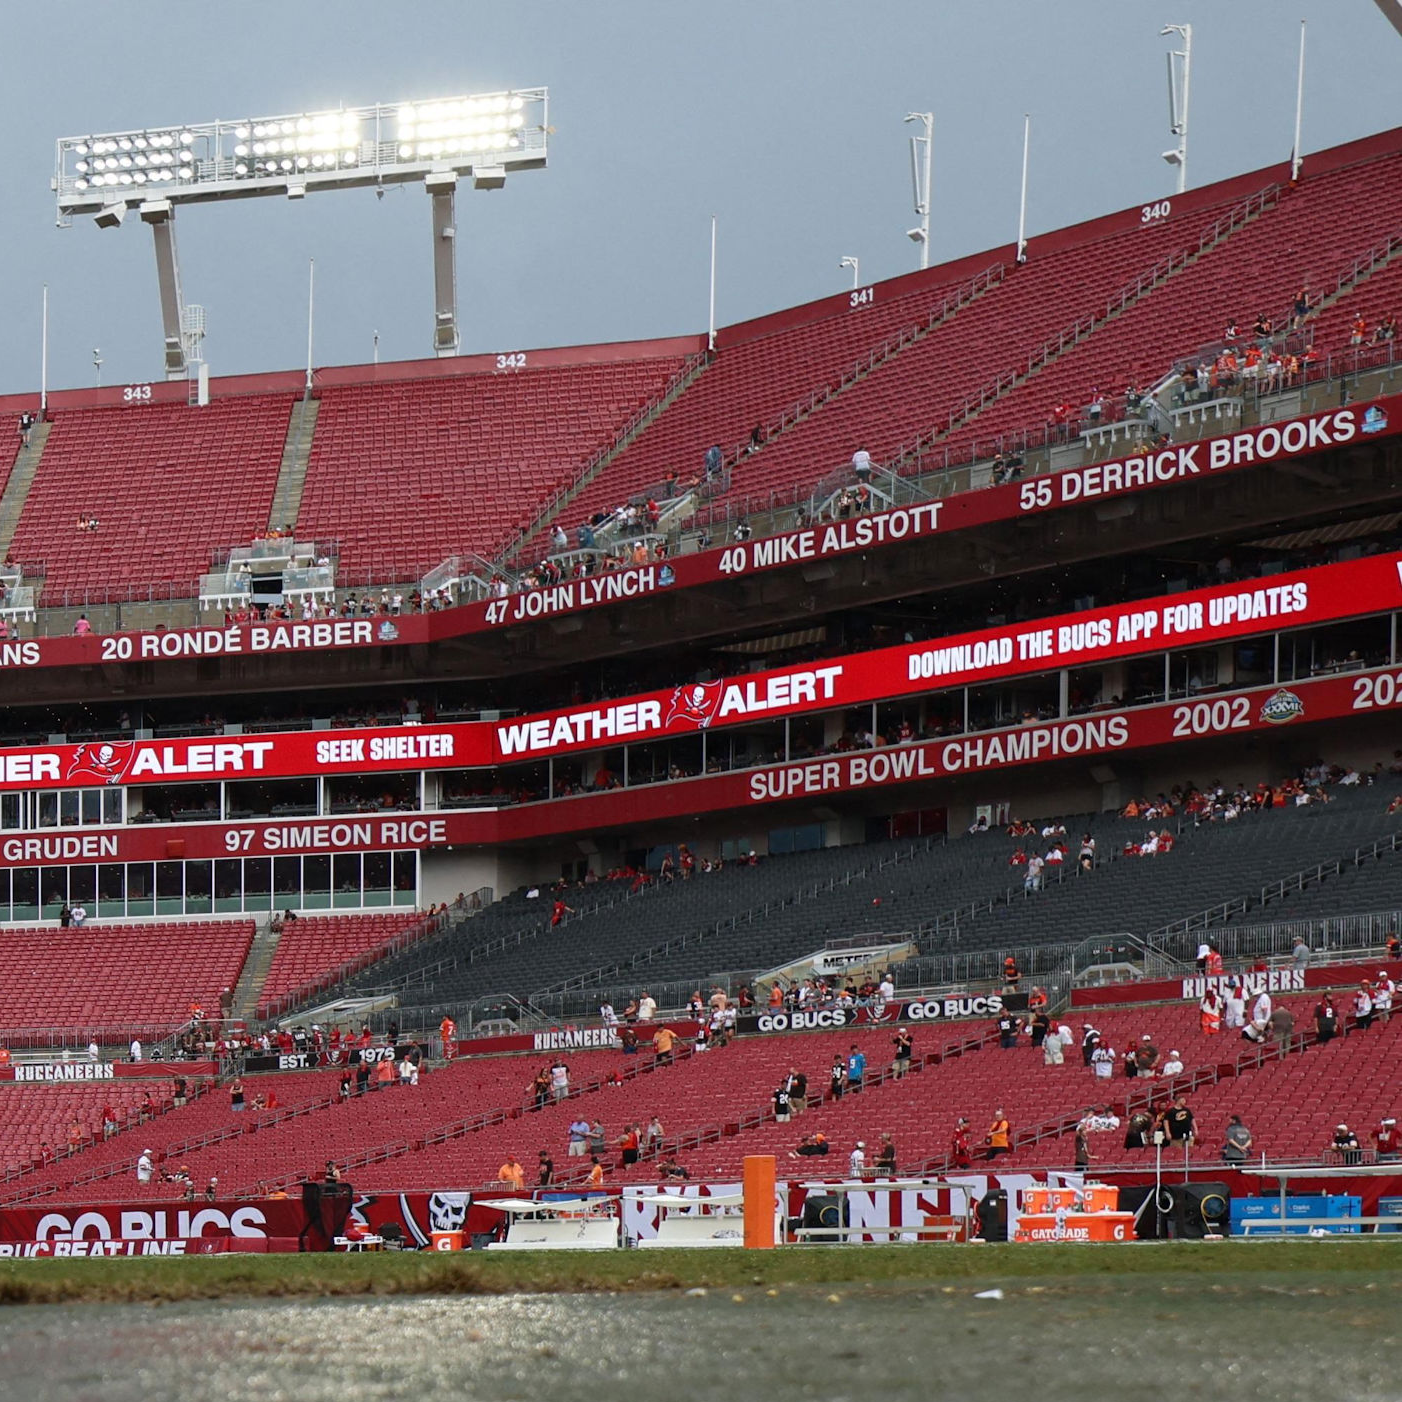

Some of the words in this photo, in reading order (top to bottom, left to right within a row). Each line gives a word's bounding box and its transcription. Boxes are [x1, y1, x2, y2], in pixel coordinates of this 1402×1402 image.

[1140, 201, 1171, 223] 340
[849, 287, 874, 308] 341
[496, 353, 527, 369] 342
[123, 386, 152, 401] 343
[1019, 479, 1053, 511] 55
[1060, 445, 1200, 502] DERRICK
[1209, 410, 1356, 469] BROOKS
[718, 546, 746, 575] 40
[752, 531, 816, 568] MIKE
[821, 502, 944, 554] ALSTOTT
[484, 600, 510, 625] 47
[513, 584, 574, 621] JOHN
[580, 566, 655, 605] LYNCH
[101, 637, 132, 660] 20
[140, 626, 245, 658] RONDÉ
[251, 620, 373, 651] BARBER
[908, 638, 1012, 681] DOWNLOAD
[1017, 628, 1053, 661] THE
[1057, 618, 1112, 654] BUCS
[1116, 611, 1158, 643] APP
[1162, 601, 1203, 634] FOR
[1208, 582, 1308, 628] UPDATES
[497, 699, 661, 756] WEATHER
[718, 665, 843, 717] ALERT
[1172, 696, 1251, 737] 2002
[130, 742, 274, 777] ALERT
[316, 738, 365, 764] SEEK
[370, 733, 455, 761] SHELTER
[750, 762, 841, 801] SUPER
[849, 749, 935, 787] BOWL
[941, 715, 1129, 772] CHAMPIONS
[3, 834, 118, 863] GRUDEN
[224, 830, 258, 852] 97
[262, 823, 375, 851] SIMEON
[380, 820, 447, 844] RICE
[757, 1013, 788, 1032] GO
[791, 1009, 846, 1029] BUCS
[907, 1001, 941, 1020] GO
[944, 996, 1003, 1017] BUCS
[534, 1028, 617, 1050] BUCCANEERS
[15, 1064, 114, 1081] BUCCANEERS
[279, 1055, 309, 1069] EST.
[358, 1047, 396, 1062] 1976
[36, 1212, 112, 1241] GO
[121, 1206, 267, 1240] BUCS
